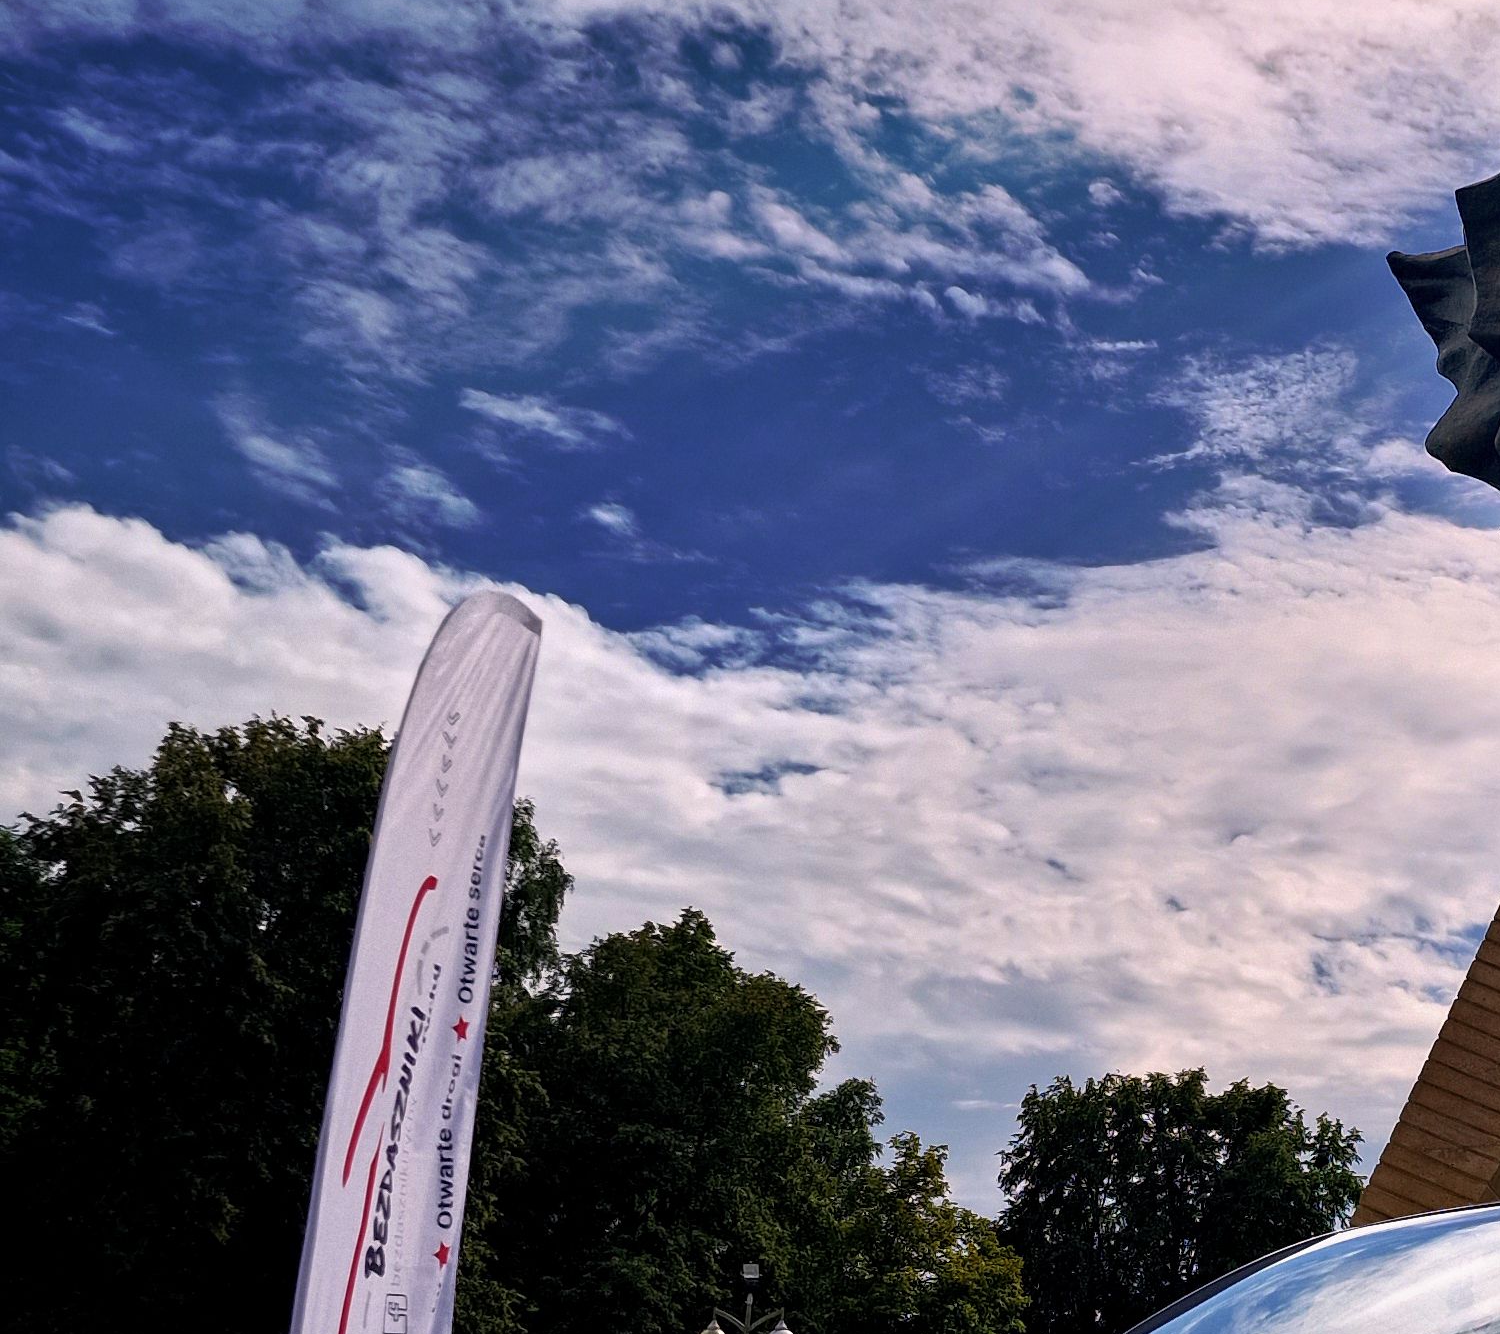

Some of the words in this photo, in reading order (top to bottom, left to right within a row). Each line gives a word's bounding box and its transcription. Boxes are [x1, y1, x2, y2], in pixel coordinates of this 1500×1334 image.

[468, 834, 487, 901] serca
[457, 907, 480, 1004] Otwarte
[441, 1054, 463, 1120] drogi
[364, 1005, 427, 1278] BEZDASZNIKI
[436, 1127, 455, 1229] Otwarte
